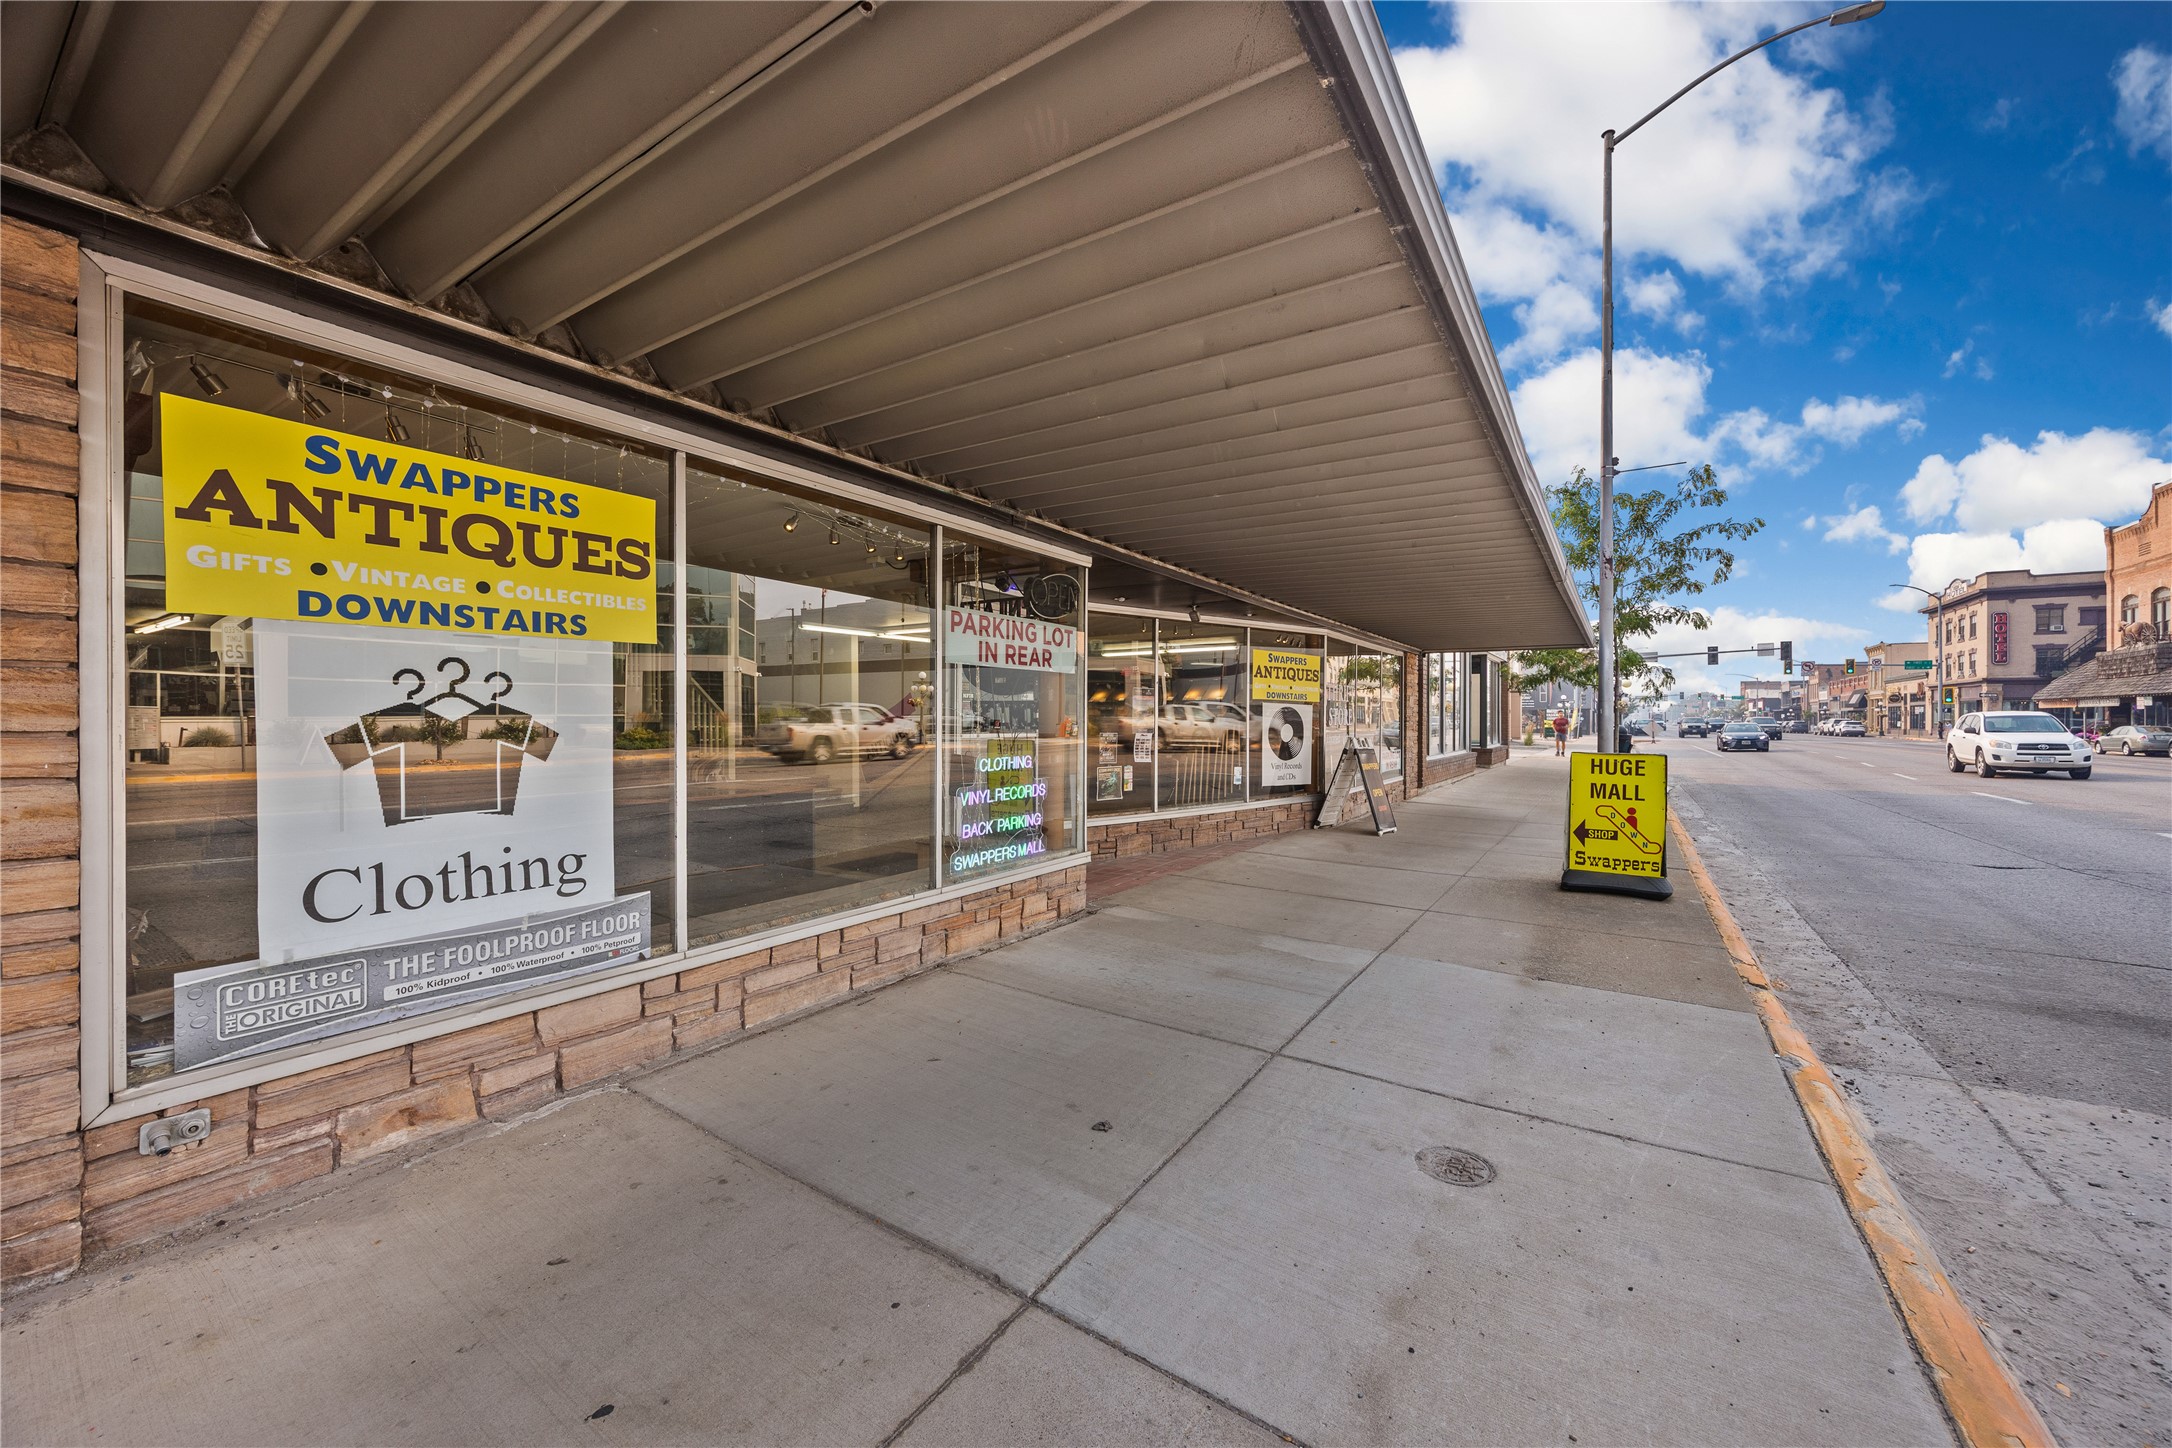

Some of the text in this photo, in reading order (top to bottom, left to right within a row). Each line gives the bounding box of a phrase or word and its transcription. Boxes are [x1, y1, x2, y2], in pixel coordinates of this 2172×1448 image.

[304, 435, 580, 518] SWAPPERS
[175, 469, 651, 580] ANTIQUES
[186, 544, 647, 612] GIFTS VINTAGE COLLECTIBLES
[1031, 577, 1078, 611] OPEN
[297, 590, 587, 637] DOWNSTAIRS
[950, 610, 1037, 643] PARKING
[1043, 625, 1074, 648] LOT
[978, 640, 1052, 668] IN REAR
[1995, 614, 2007, 662] HOTEL
[1254, 665, 1319, 682] ANTIQUES
[1268, 653, 1307, 666] SWAPPERS
[1266, 691, 1308, 700] DOWNSTAIRS
[1329, 708, 1353, 726] STORE
[979, 755, 1033, 773] CLOTHING
[1590, 758, 1646, 777] HUGE
[961, 783, 1047, 807] VINYL RECORDS
[1590, 782, 1645, 801] MALL
[962, 820, 993, 839] BACK
[997, 813, 1042, 832] PARKING
[1588, 829, 1615, 840] SHOP
[1610, 812, 1649, 849] DOWN
[954, 839, 1046, 871] SWAPPERS MALL
[1574, 850, 1660, 873] Swappers
[302, 846, 587, 923] Clothing
[384, 911, 641, 980] THE FOOLPROOF FLOOR
[395, 982, 424, 996] 100%
[426, 972, 471, 989] Kidproof
[491, 962, 515, 974] 100%
[516, 952, 565, 969] Waterproof
[581, 942, 602, 954] 100%
[604, 936, 635, 949] Petproof
[225, 990, 359, 1035] THE ORIGINAL
